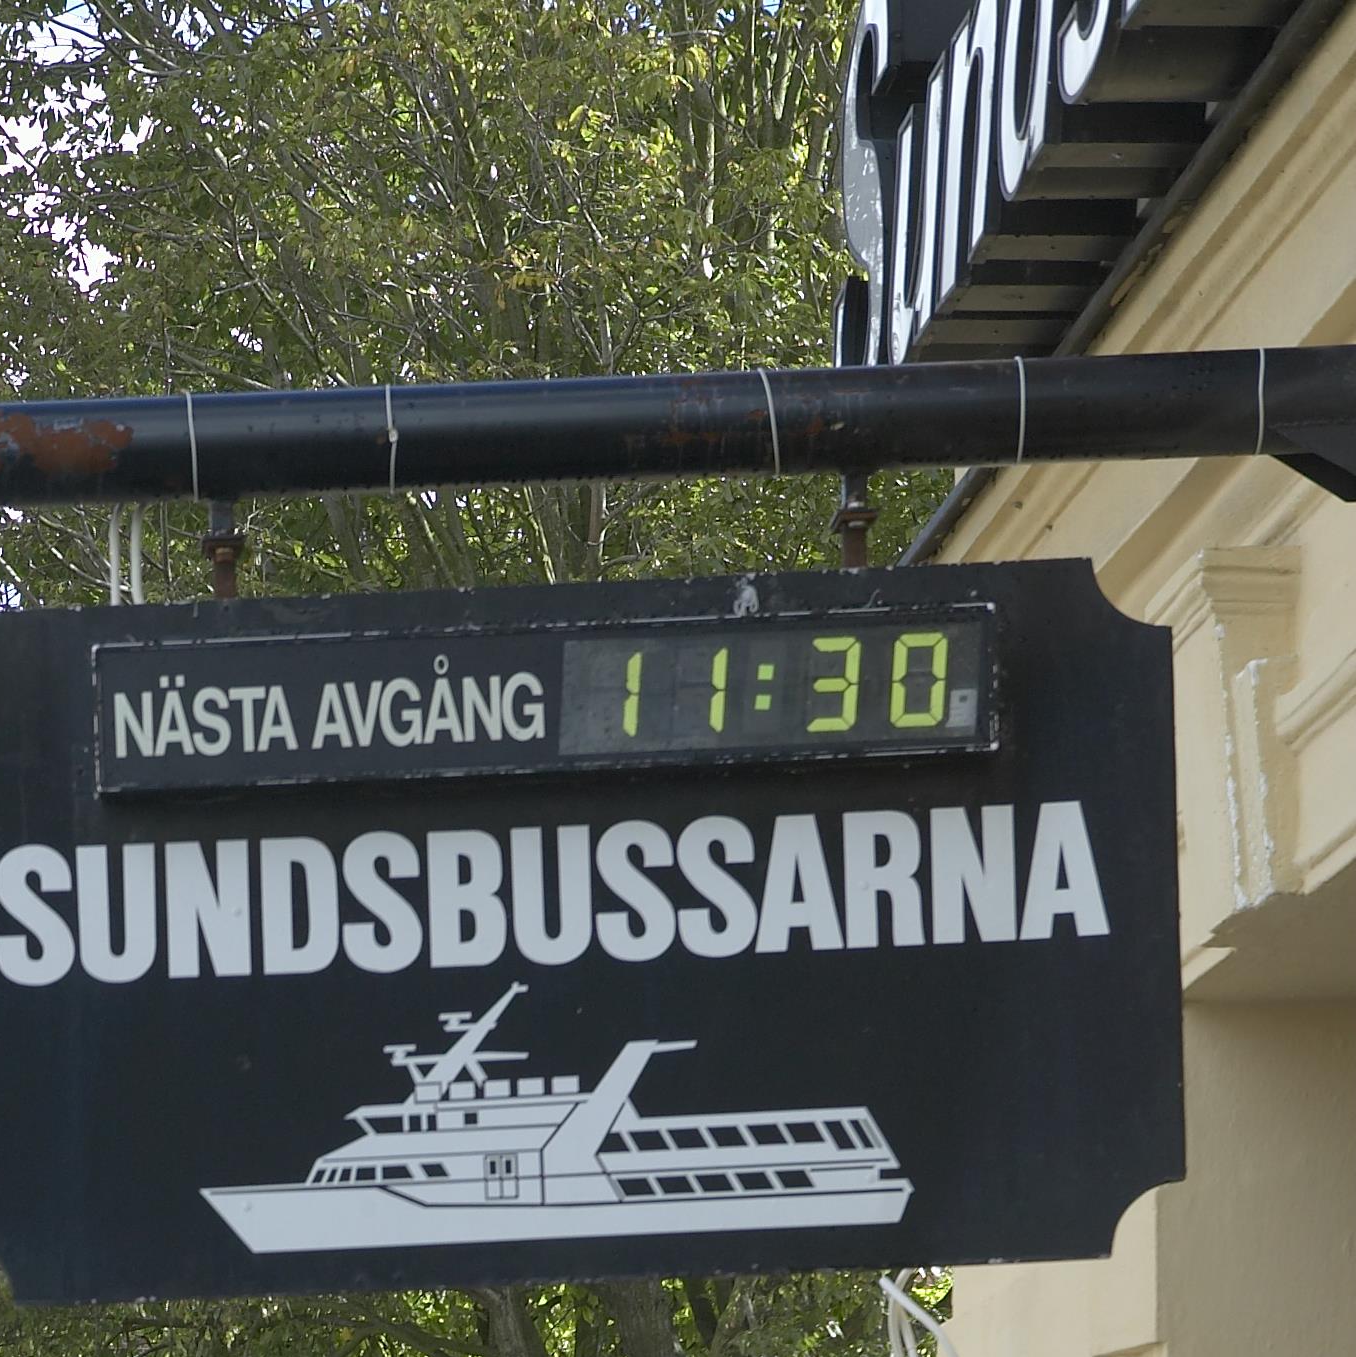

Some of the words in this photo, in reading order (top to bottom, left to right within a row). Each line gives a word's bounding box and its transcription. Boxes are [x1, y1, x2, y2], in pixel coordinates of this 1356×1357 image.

[114, 675, 298, 758] NÄSTA
[312, 655, 545, 749] AVGÅNG
[623, 632, 948, 737] 11:30
